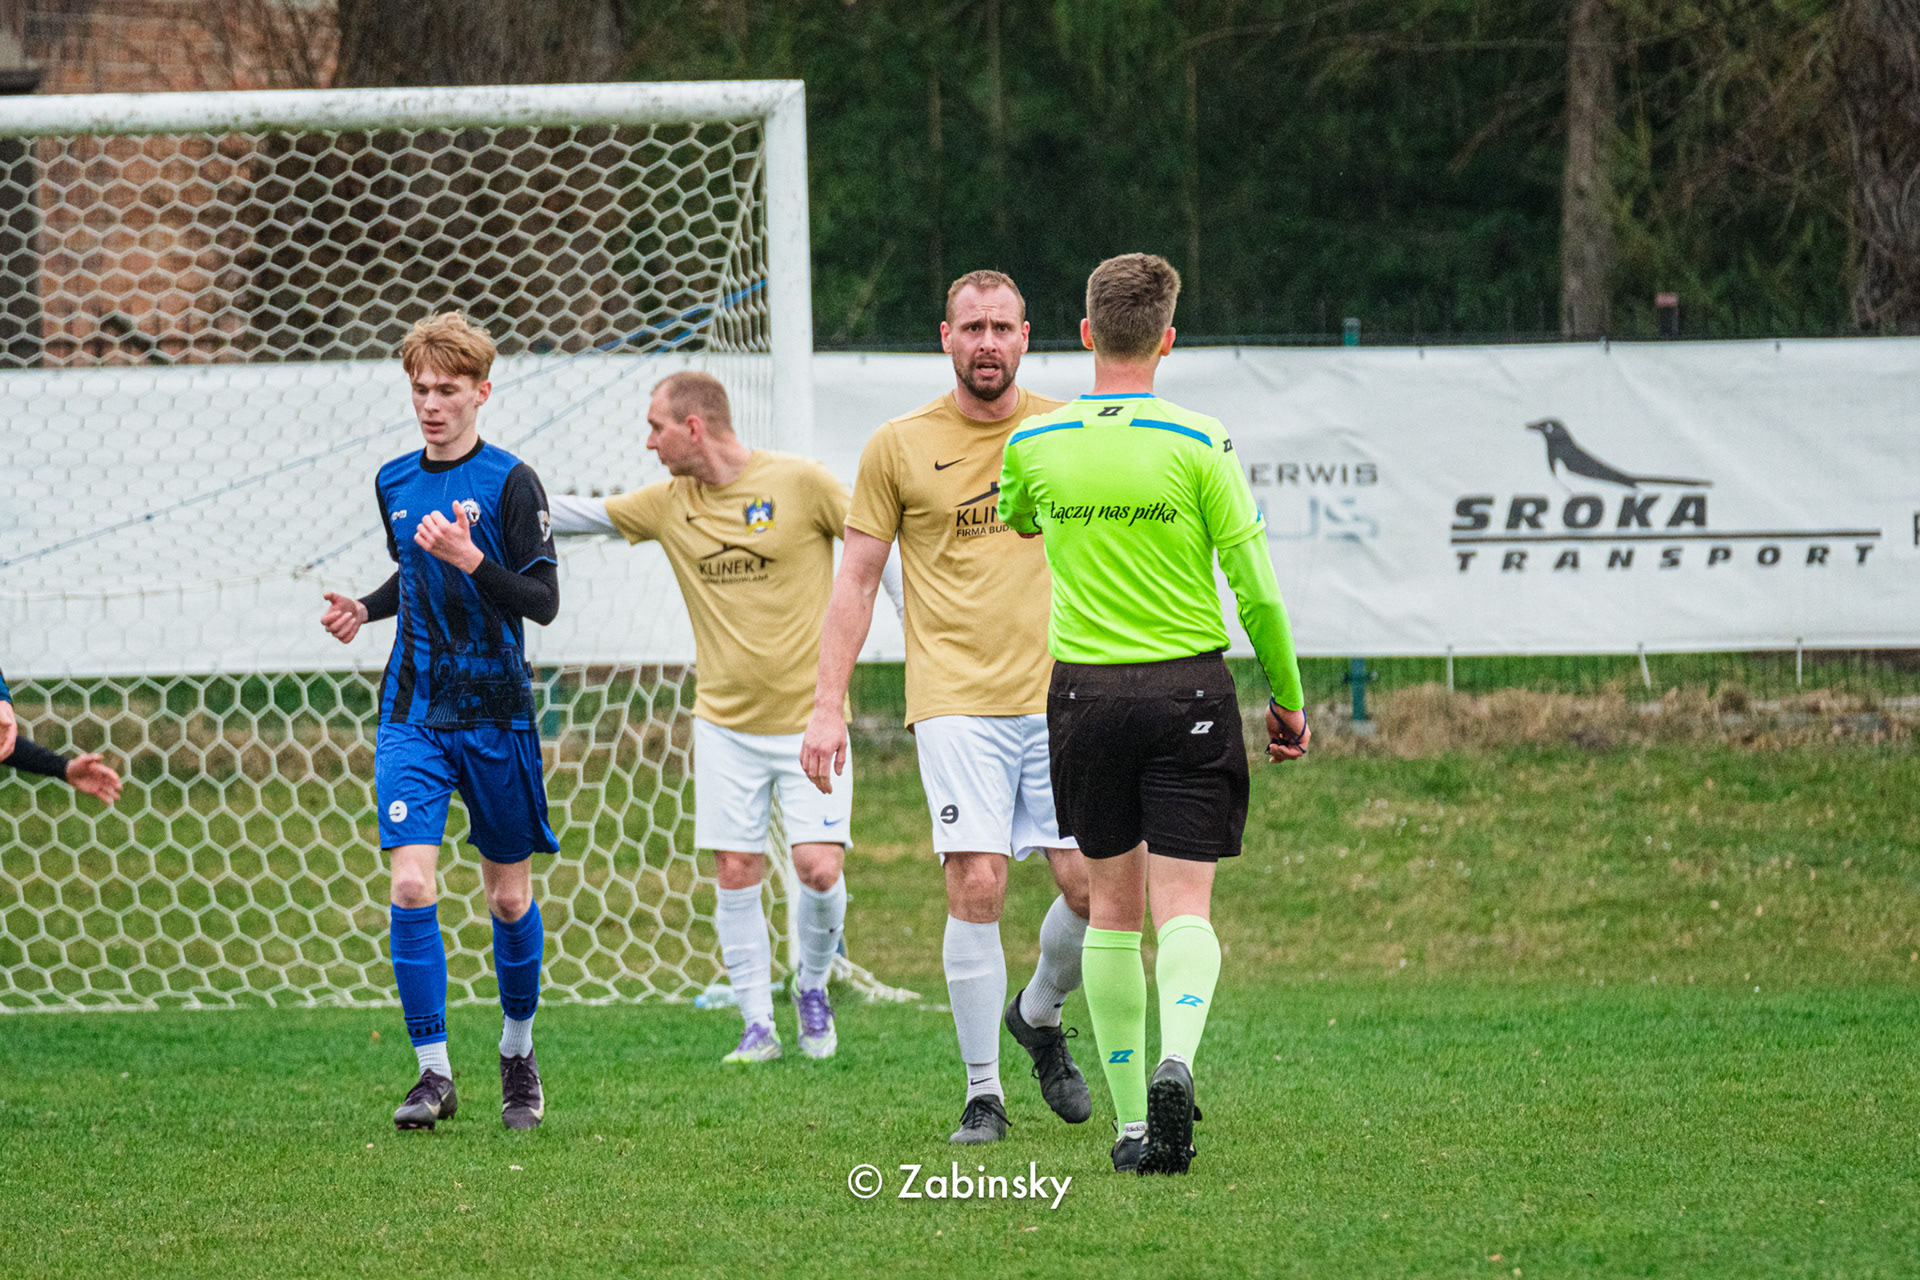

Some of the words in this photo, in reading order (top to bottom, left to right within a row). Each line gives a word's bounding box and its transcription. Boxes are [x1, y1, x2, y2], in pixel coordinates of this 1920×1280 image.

[1250, 463, 1378, 486] ERWIS
[1097, 505, 1131, 521] nas
[1128, 502, 1177, 527] piłka
[1451, 493, 1709, 532] SROKA
[956, 526, 987, 538] FIRMA
[988, 524, 1010, 535] BUD
[698, 560, 755, 576] KLINEK
[1455, 544, 1875, 573] TRANSPORT
[389, 800, 408, 823] 9
[940, 804, 959, 824] 9
